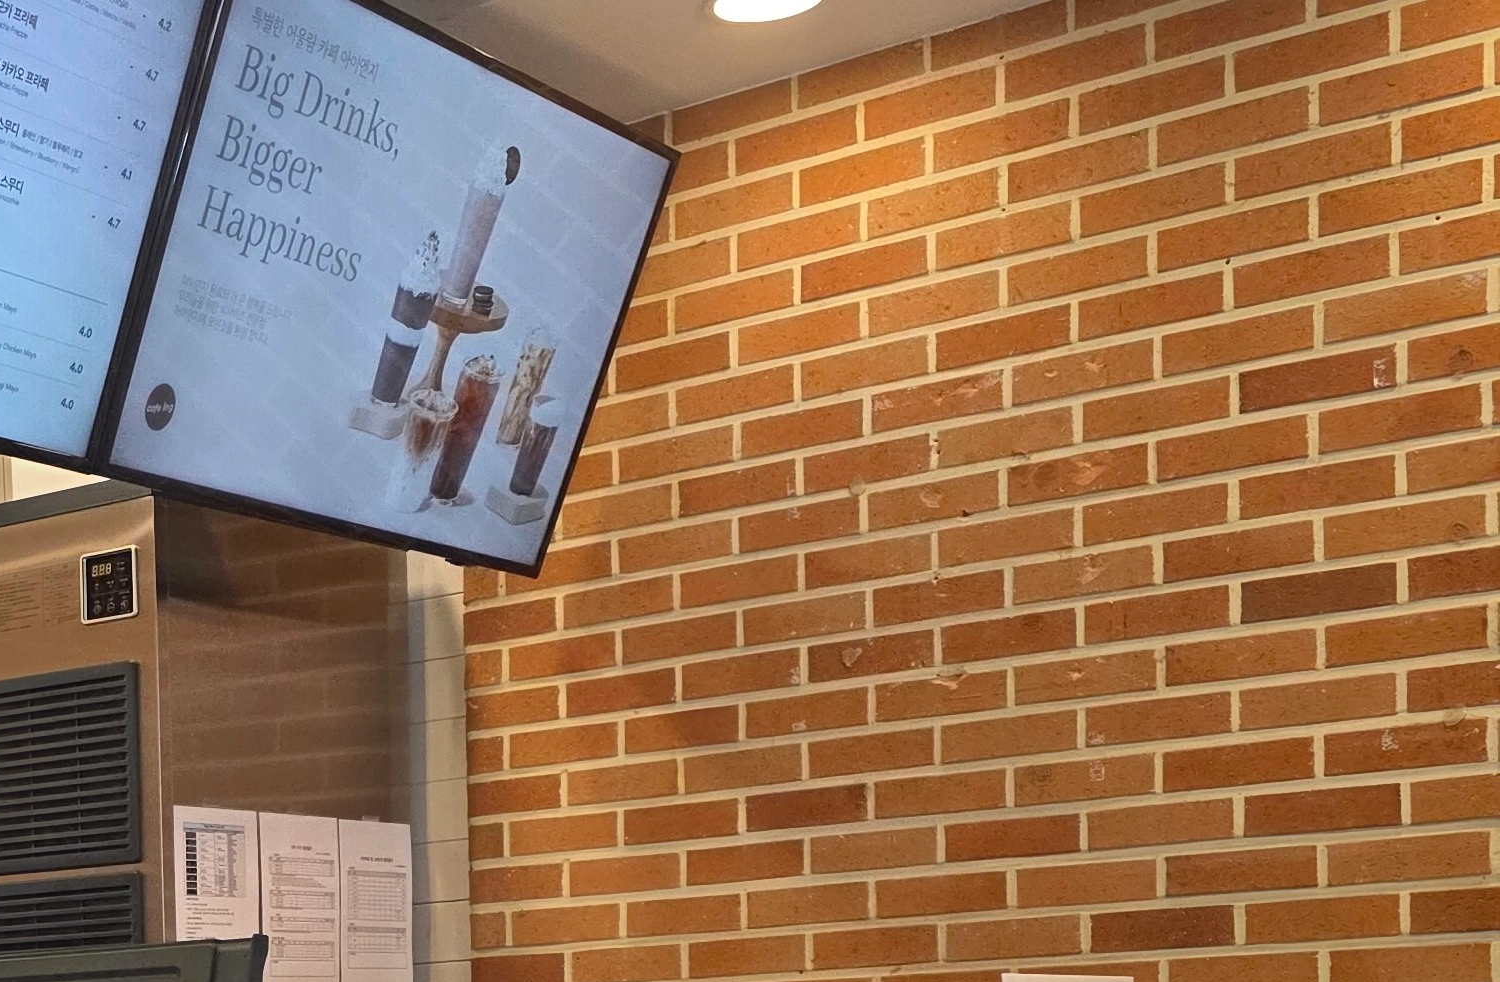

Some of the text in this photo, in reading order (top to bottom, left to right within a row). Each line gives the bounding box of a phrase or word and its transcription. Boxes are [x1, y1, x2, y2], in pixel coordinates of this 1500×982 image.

[158, 18, 172, 32] 4.2
[0, 60, 24, 81] 카카오
[145, 68, 159, 82] 4.7
[235, 44, 399, 162] Big Drinks,
[132, 118, 146, 132] 4.7
[216, 114, 323, 194] Bigger
[0, 175, 24, 195] 스무디
[197, 184, 362, 283] Happiness
[78, 325, 93, 339] 4.0
[69, 361, 83, 374] 4.0
[60, 397, 74, 410] 4.0
